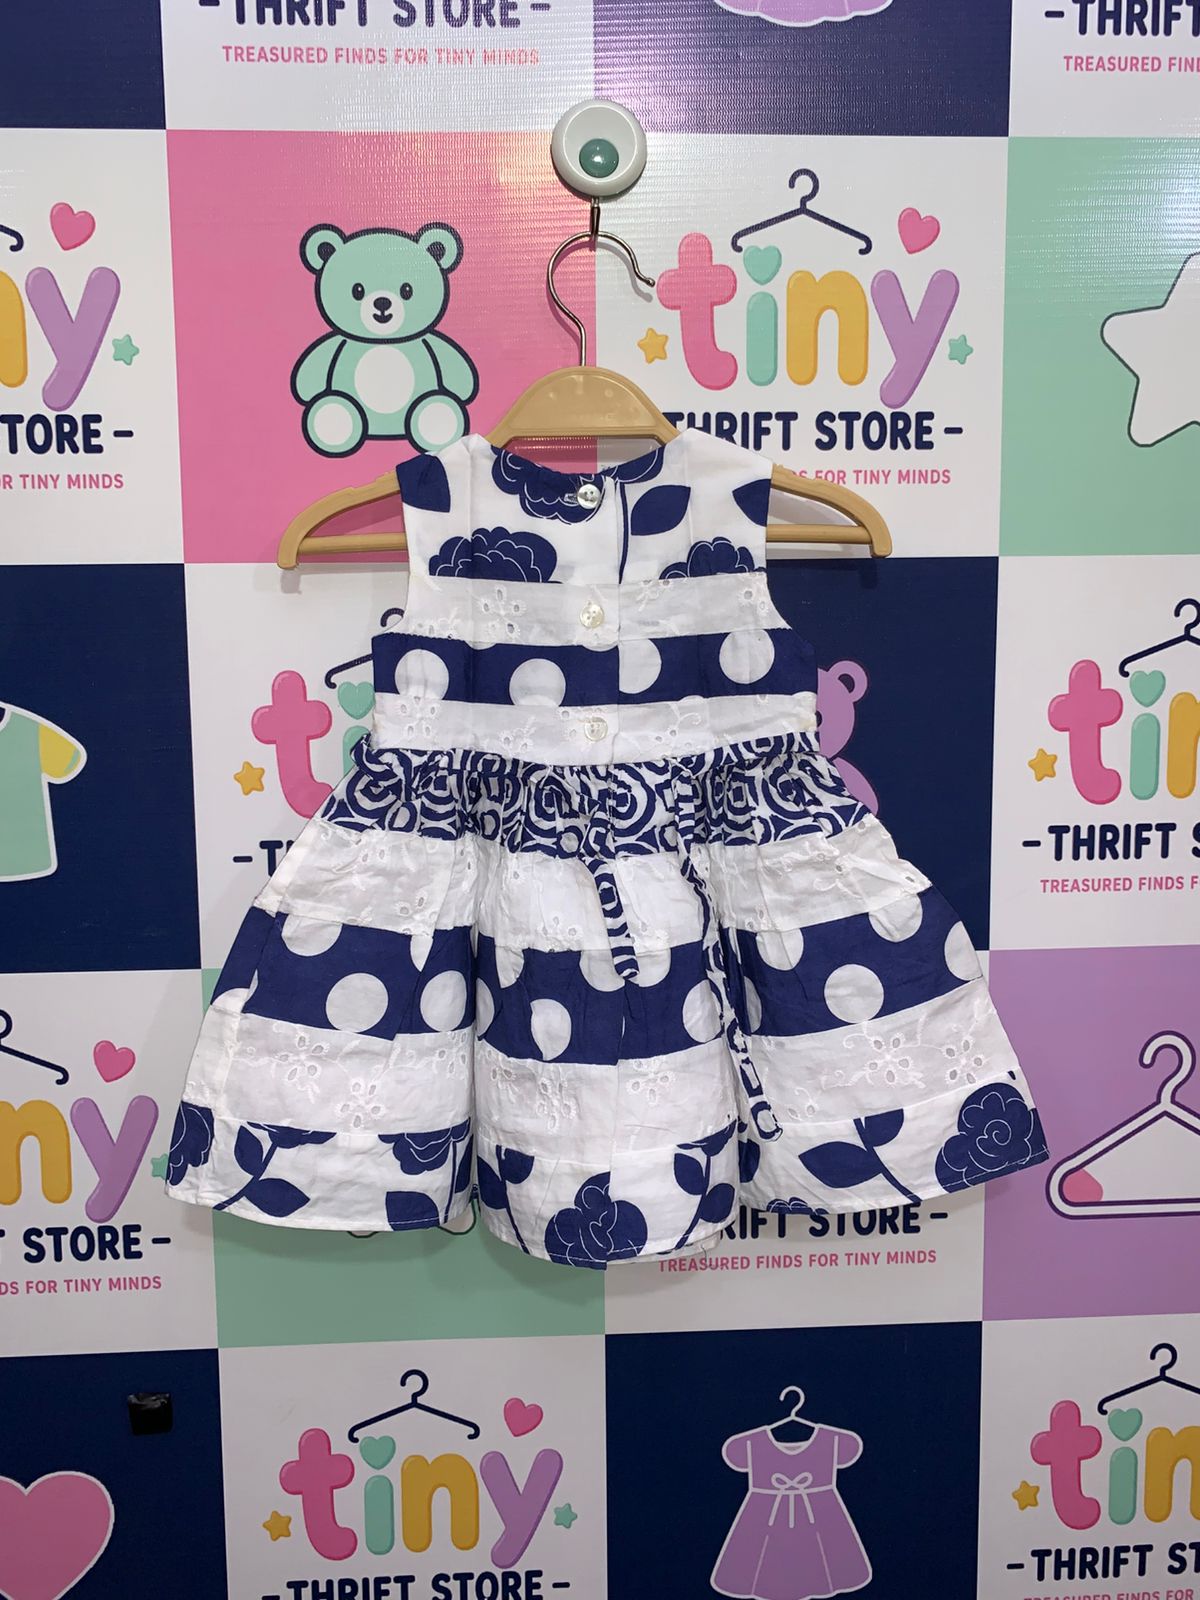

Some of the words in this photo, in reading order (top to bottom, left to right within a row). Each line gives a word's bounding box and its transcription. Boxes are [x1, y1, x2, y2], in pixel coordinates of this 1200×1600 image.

[222, 46, 328, 63] TREASURED
[335, 48, 388, 64] FINDS
[394, 49, 429, 64] FOR
[435, 49, 475, 64] TINY
[483, 49, 540, 65] MINDS
[1064, 56, 1162, 72] TREASURED
[1168, 57, 1200, 72] FIN
[657, 233, 959, 408] tiny
[815, 411, 935, 450] STORE
[19, 474, 60, 489] TINY
[67, 474, 124, 489] MINDS
[853, 470, 891, 484] TINY
[898, 469, 951, 484] MINDS
[1048, 822, 1177, 861] THRIFT
[1040, 878, 1133, 893] TREASURED
[1138, 876, 1184, 891] FINDS
[23, 1224, 143, 1263] STORE
[659, 1256, 750, 1273] TREASURED
[757, 1254, 802, 1269] FINDS
[809, 1252, 839, 1267] FOR
[845, 1250, 880, 1266] TINY
[887, 1250, 937, 1265] MINDS
[26, 1280, 57, 1294] FOR
[64, 1278, 102, 1292] TINY
[109, 1276, 162, 1291] MINDS
[279, 1428, 563, 1569] tiny
[1031, 1544, 1153, 1581] THRIFT
